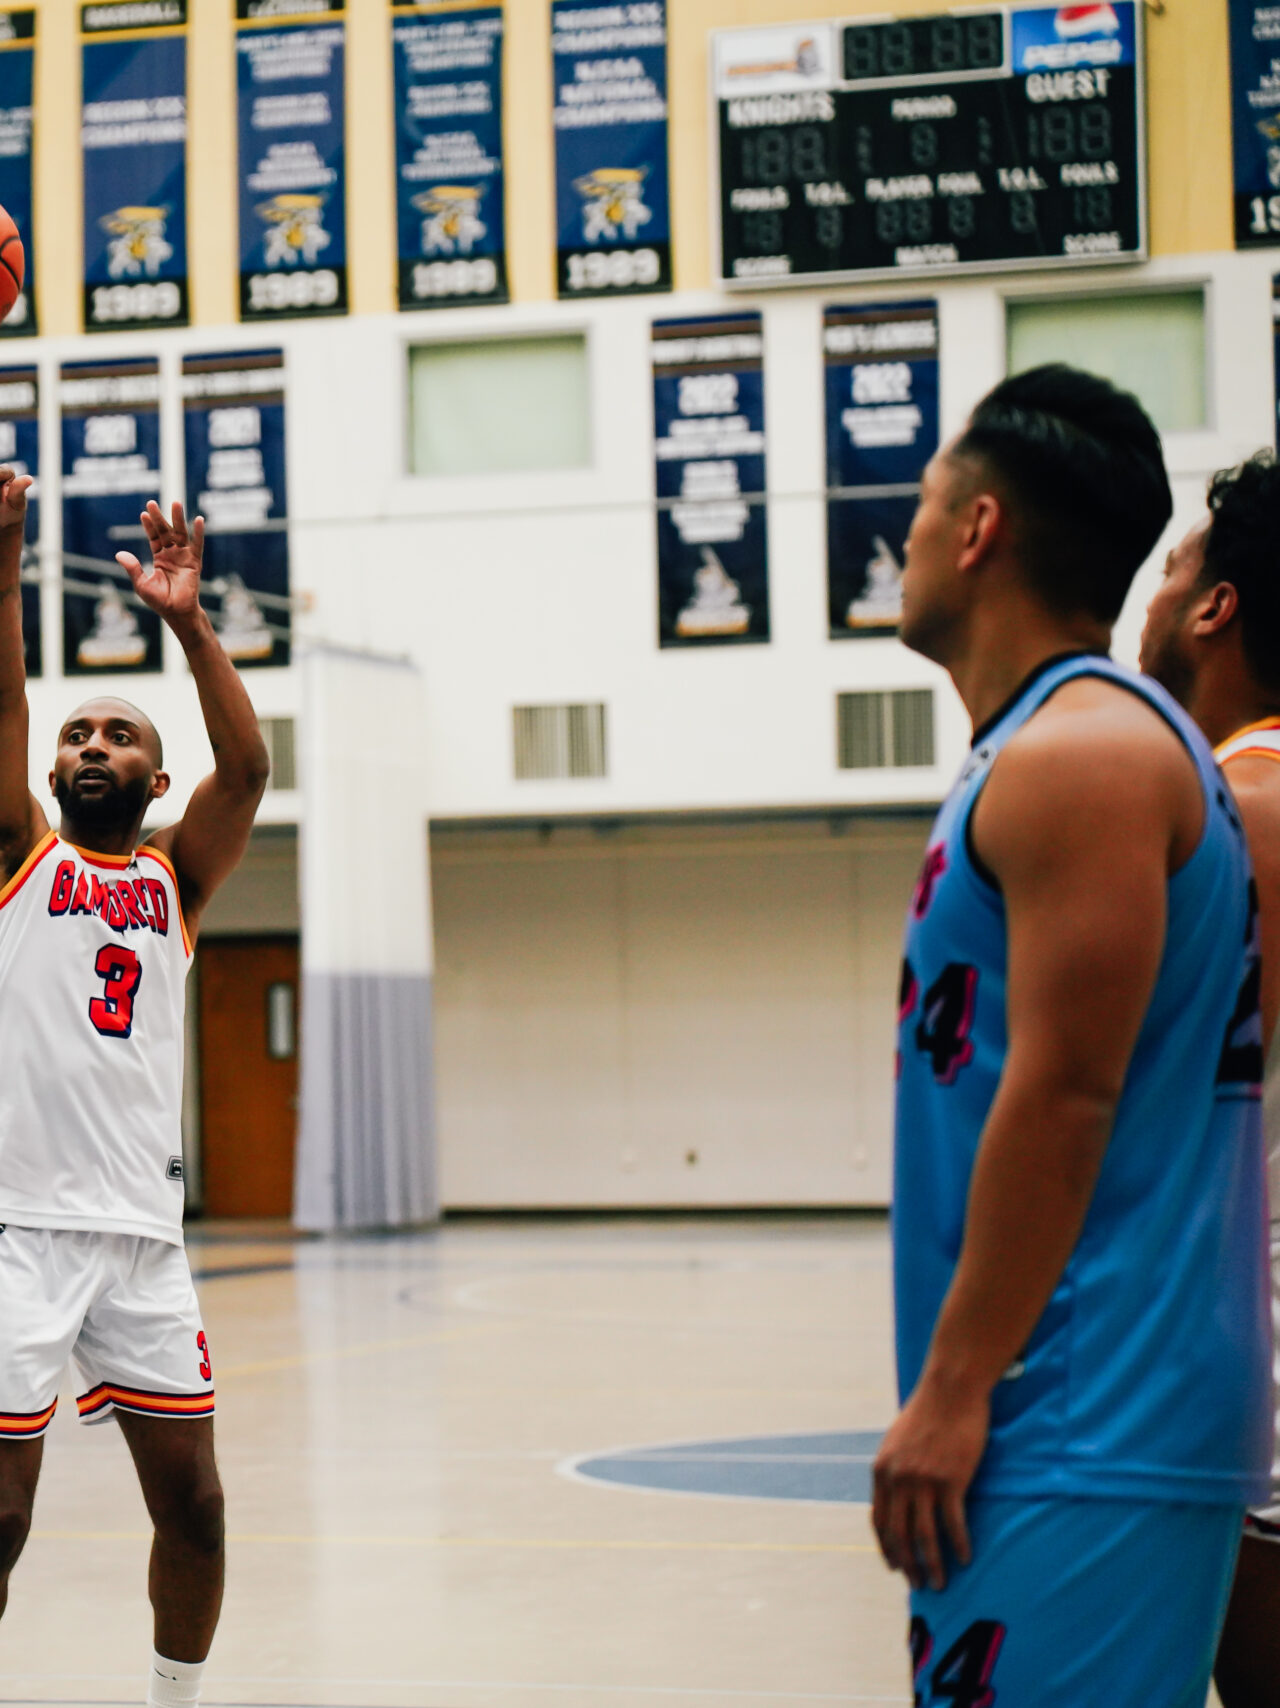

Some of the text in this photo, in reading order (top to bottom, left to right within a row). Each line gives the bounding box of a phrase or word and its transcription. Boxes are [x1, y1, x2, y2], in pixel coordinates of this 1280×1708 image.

[1022, 40, 1121, 69] PEPSI
[1025, 71, 1111, 102] GUEST
[728, 93, 836, 128] KNIGHTS
[891, 95, 957, 120] PERIOD
[865, 172, 985, 201] PLAYER FOUL
[1060, 162, 1118, 187] FOULS
[88, 943, 142, 1039] 3
[197, 1330, 212, 1382] 3
